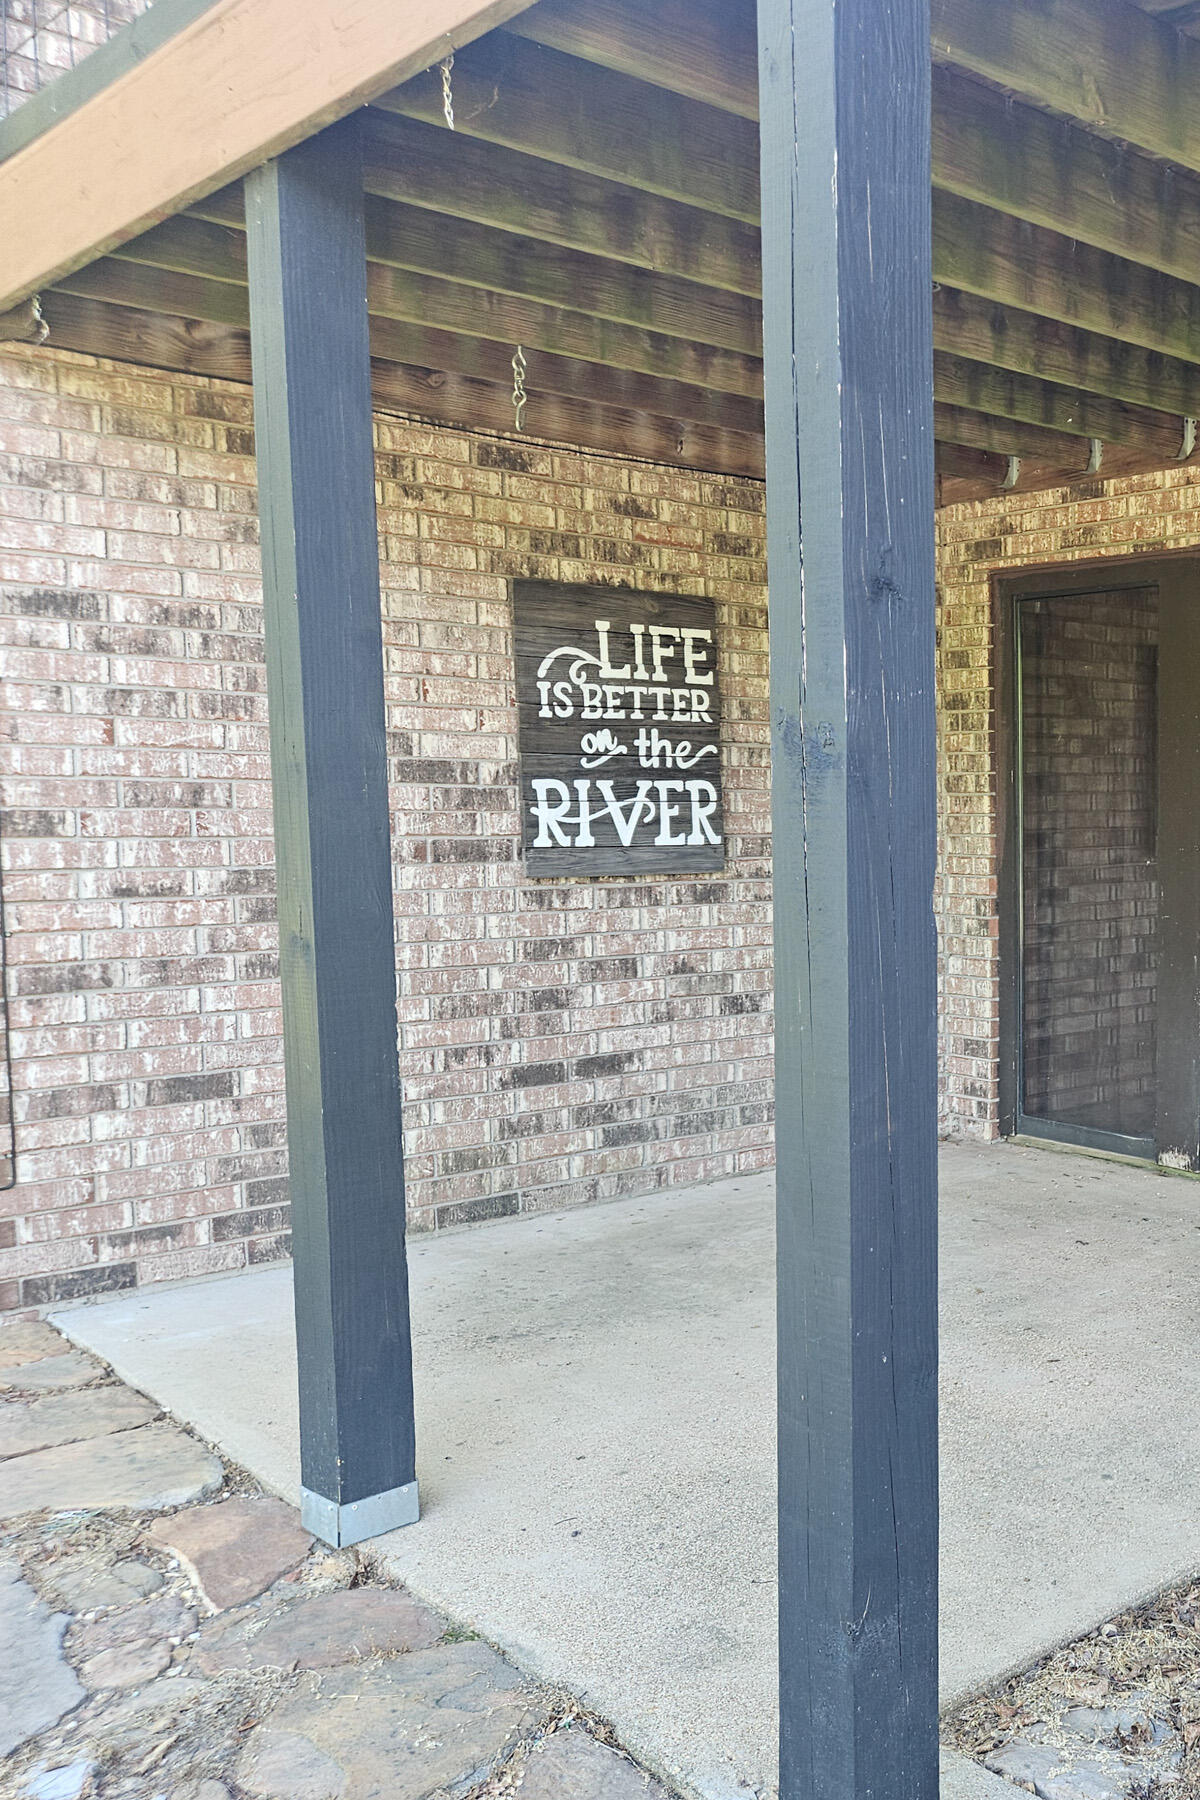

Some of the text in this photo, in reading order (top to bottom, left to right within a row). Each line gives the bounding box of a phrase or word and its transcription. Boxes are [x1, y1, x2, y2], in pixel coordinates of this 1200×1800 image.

[594, 620, 714, 686] LIFE
[536, 681, 714, 724] IS BETTER
[580, 728, 718, 769] on the
[530, 778, 722, 848] RIVER
